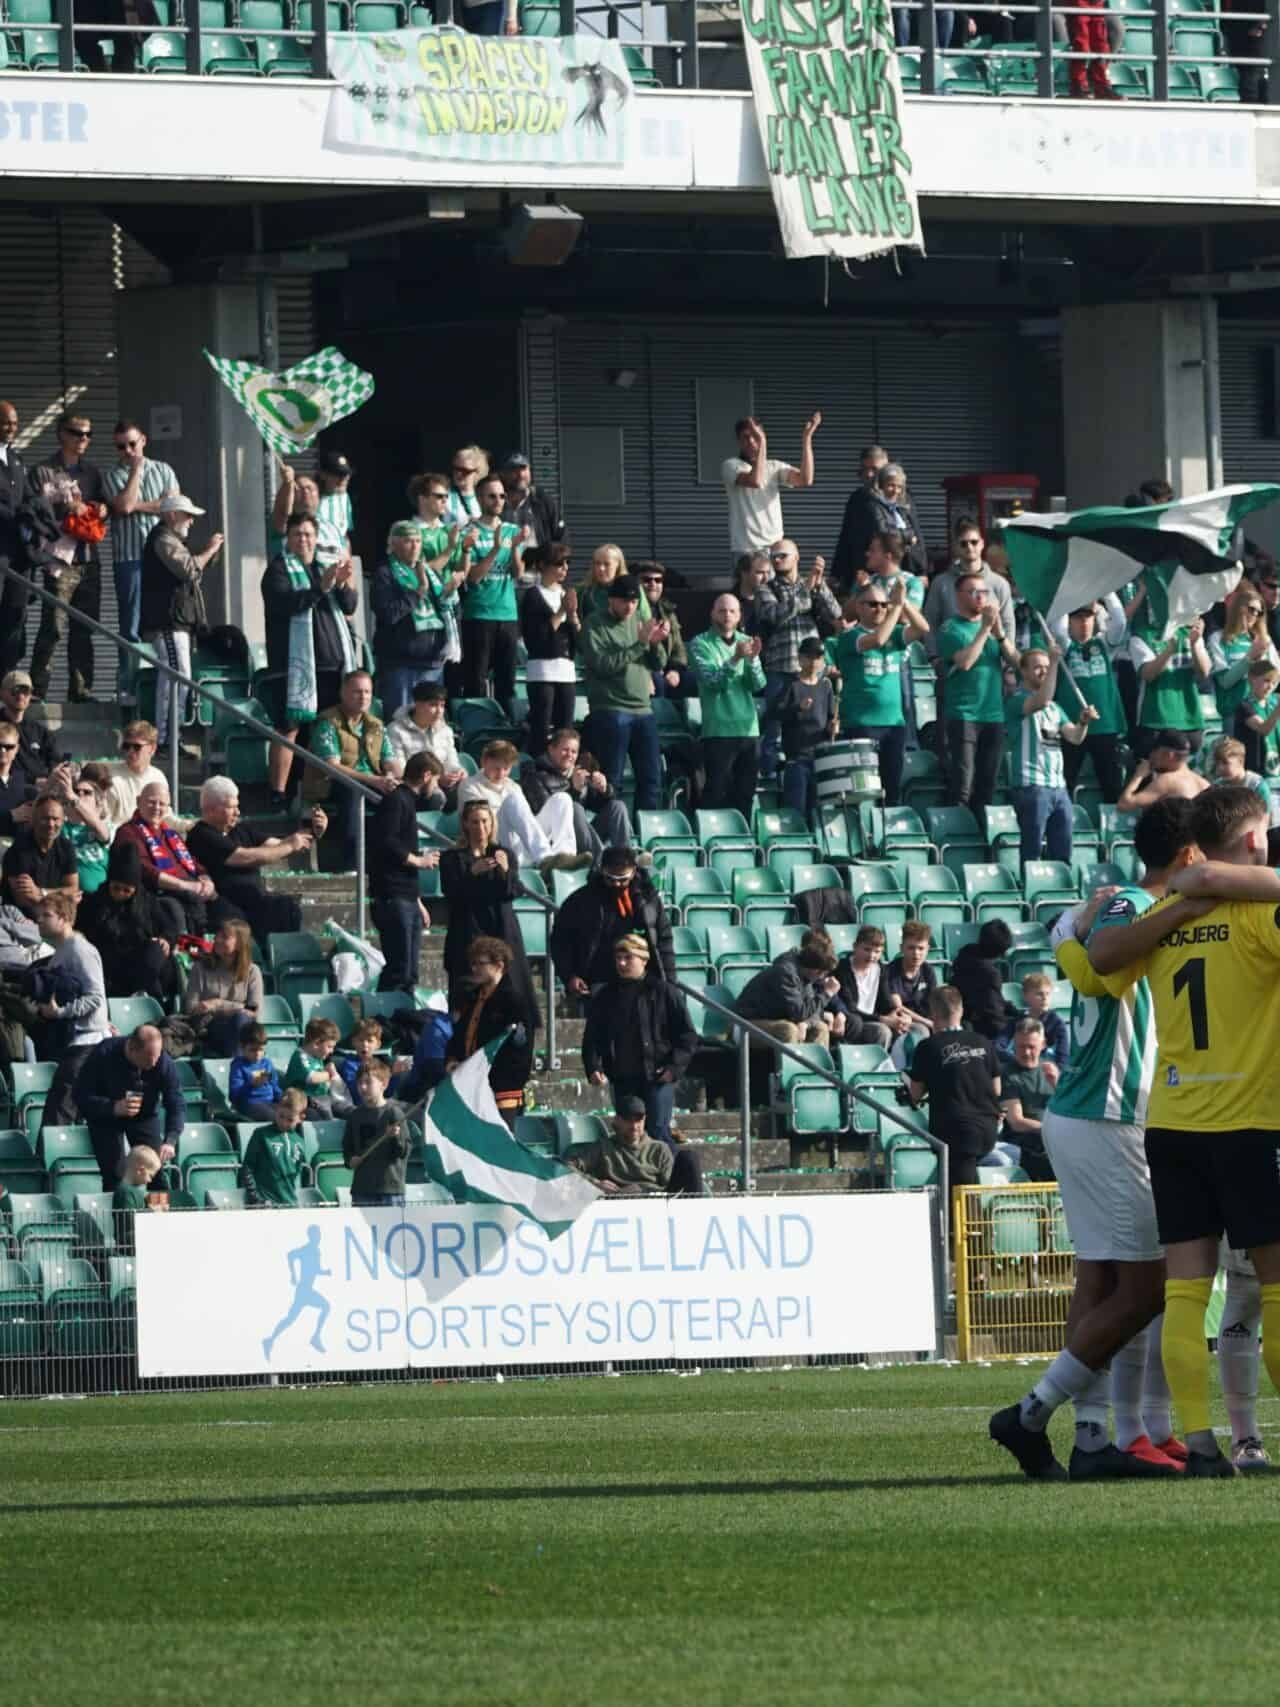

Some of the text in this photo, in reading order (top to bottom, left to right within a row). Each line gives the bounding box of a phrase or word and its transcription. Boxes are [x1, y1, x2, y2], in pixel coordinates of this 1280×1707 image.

[418, 33, 550, 90] SPACEY
[414, 86, 568, 137] INVASION
[767, 114, 846, 181] HAN
[849, 113, 912, 177] ER
[799, 174, 913, 238] LANG
[1173, 957, 1209, 1051] 1
[344, 1214, 814, 1281] NORDSJÆLLAND
[345, 1295, 813, 1354] SPORTSFYSIOTERAPI
